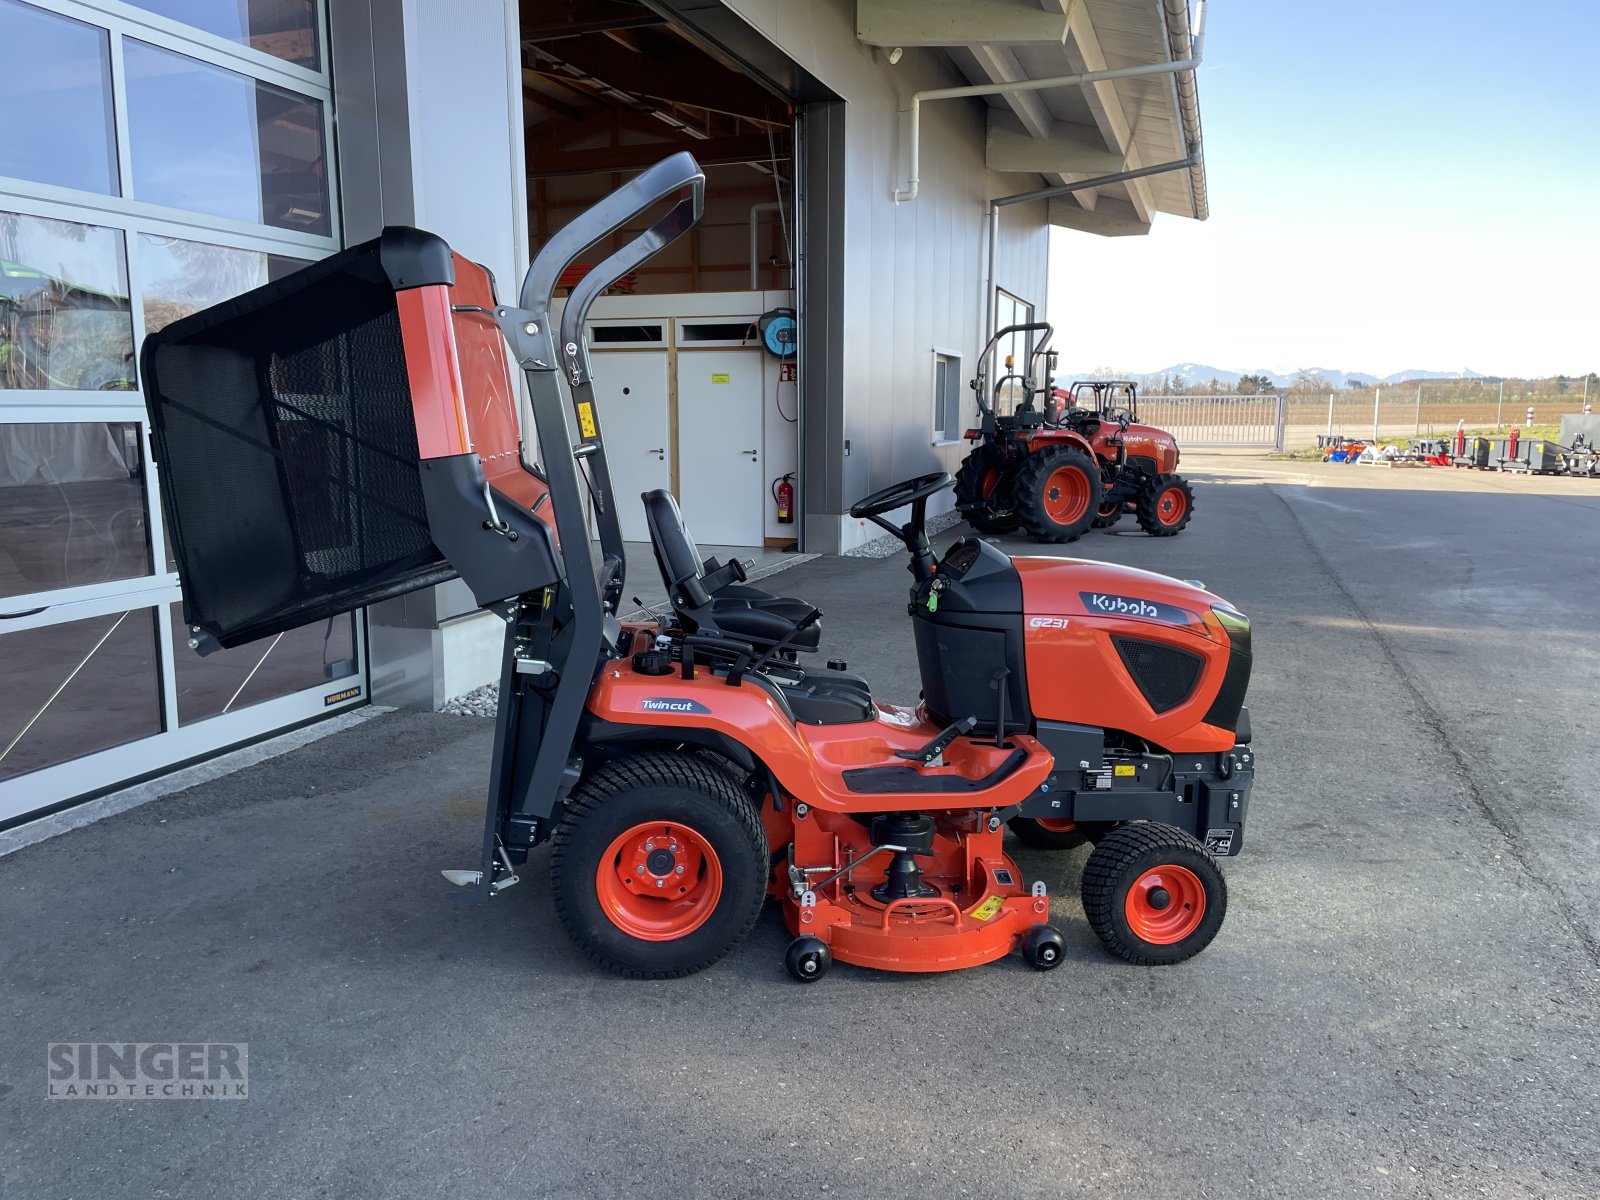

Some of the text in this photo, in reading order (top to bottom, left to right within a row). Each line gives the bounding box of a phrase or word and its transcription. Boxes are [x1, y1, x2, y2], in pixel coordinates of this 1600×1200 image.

[1092, 594, 1158, 617] Kubota
[1029, 616, 1069, 629] G231
[642, 700, 693, 711] Twincut
